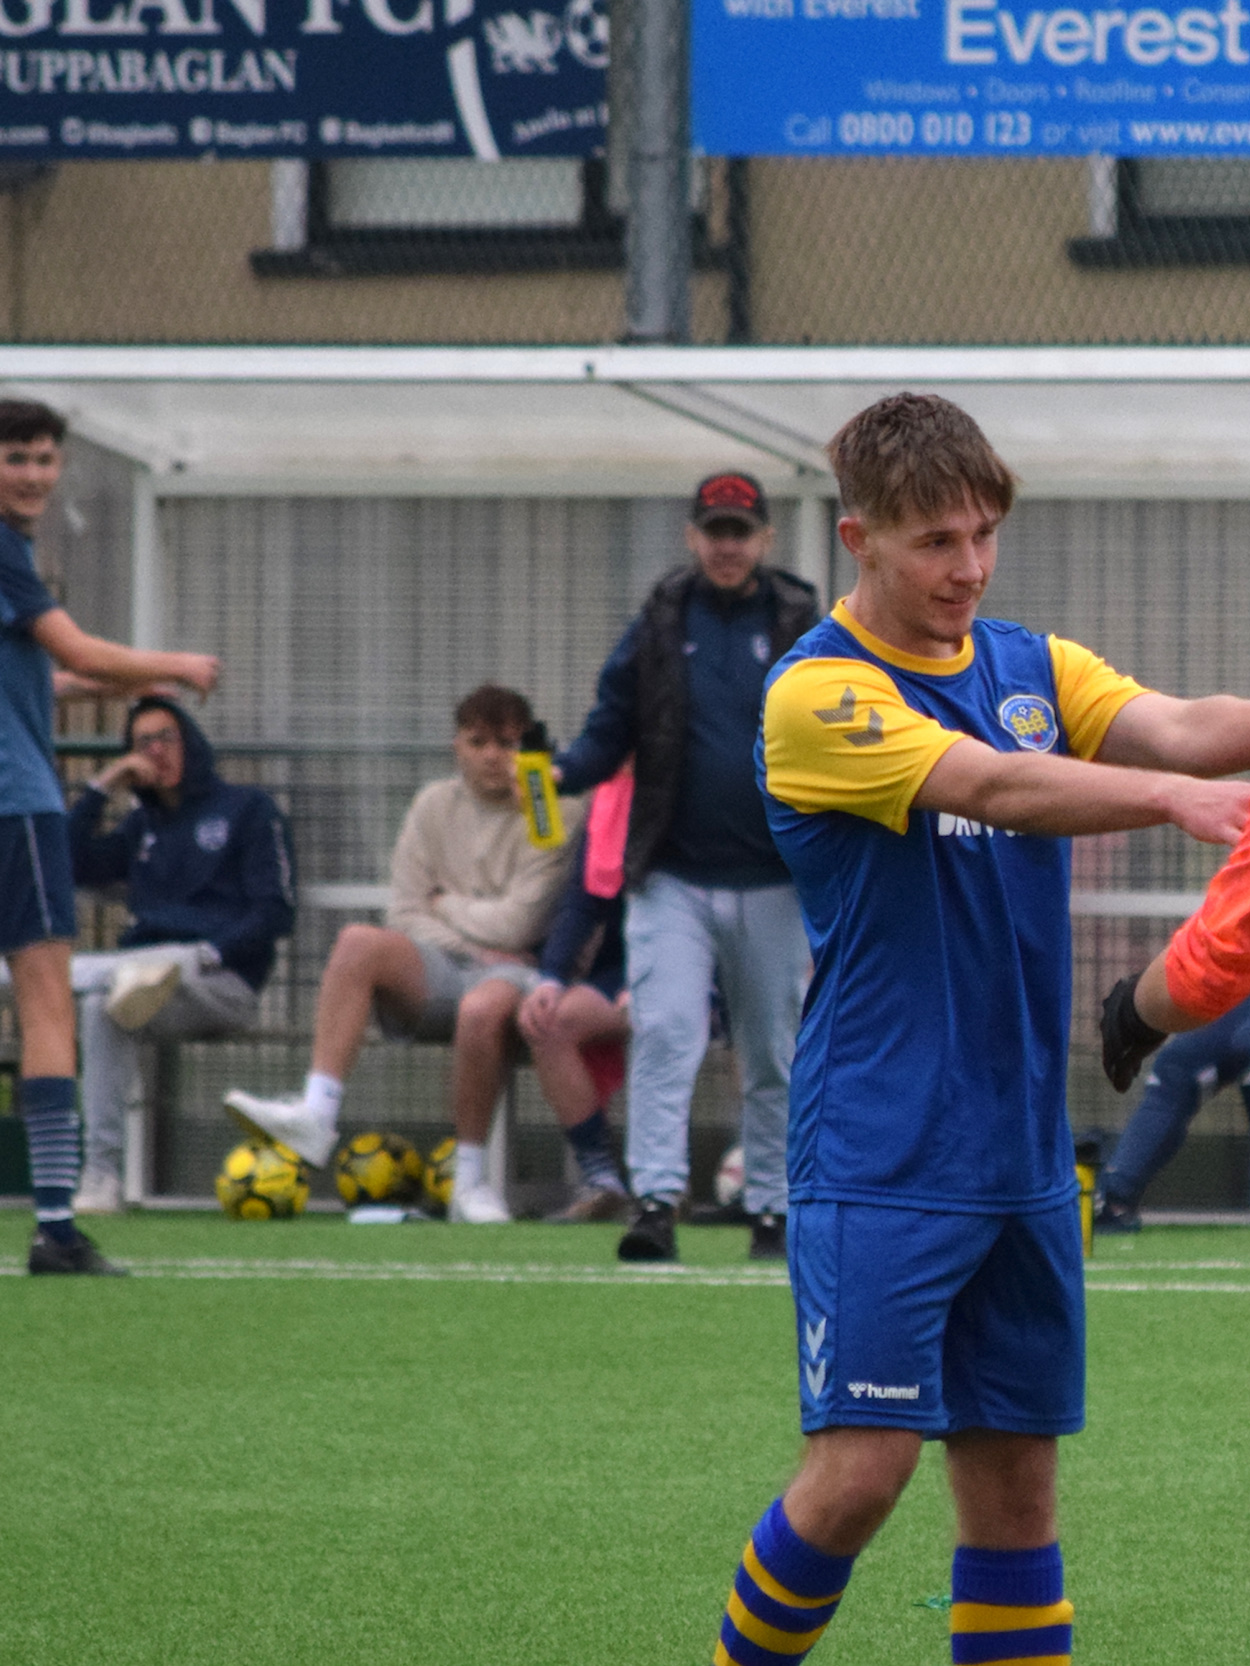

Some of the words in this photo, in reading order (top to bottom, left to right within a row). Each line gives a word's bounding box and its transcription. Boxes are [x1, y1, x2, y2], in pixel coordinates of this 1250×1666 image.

[0, 48, 298, 94] UPPABAGLAN
[785, 113, 832, 146] Call
[838, 112, 914, 146] 0800
[920, 112, 975, 145] 010
[983, 112, 1032, 145] 123
[868, 1383, 920, 1400] hummel
